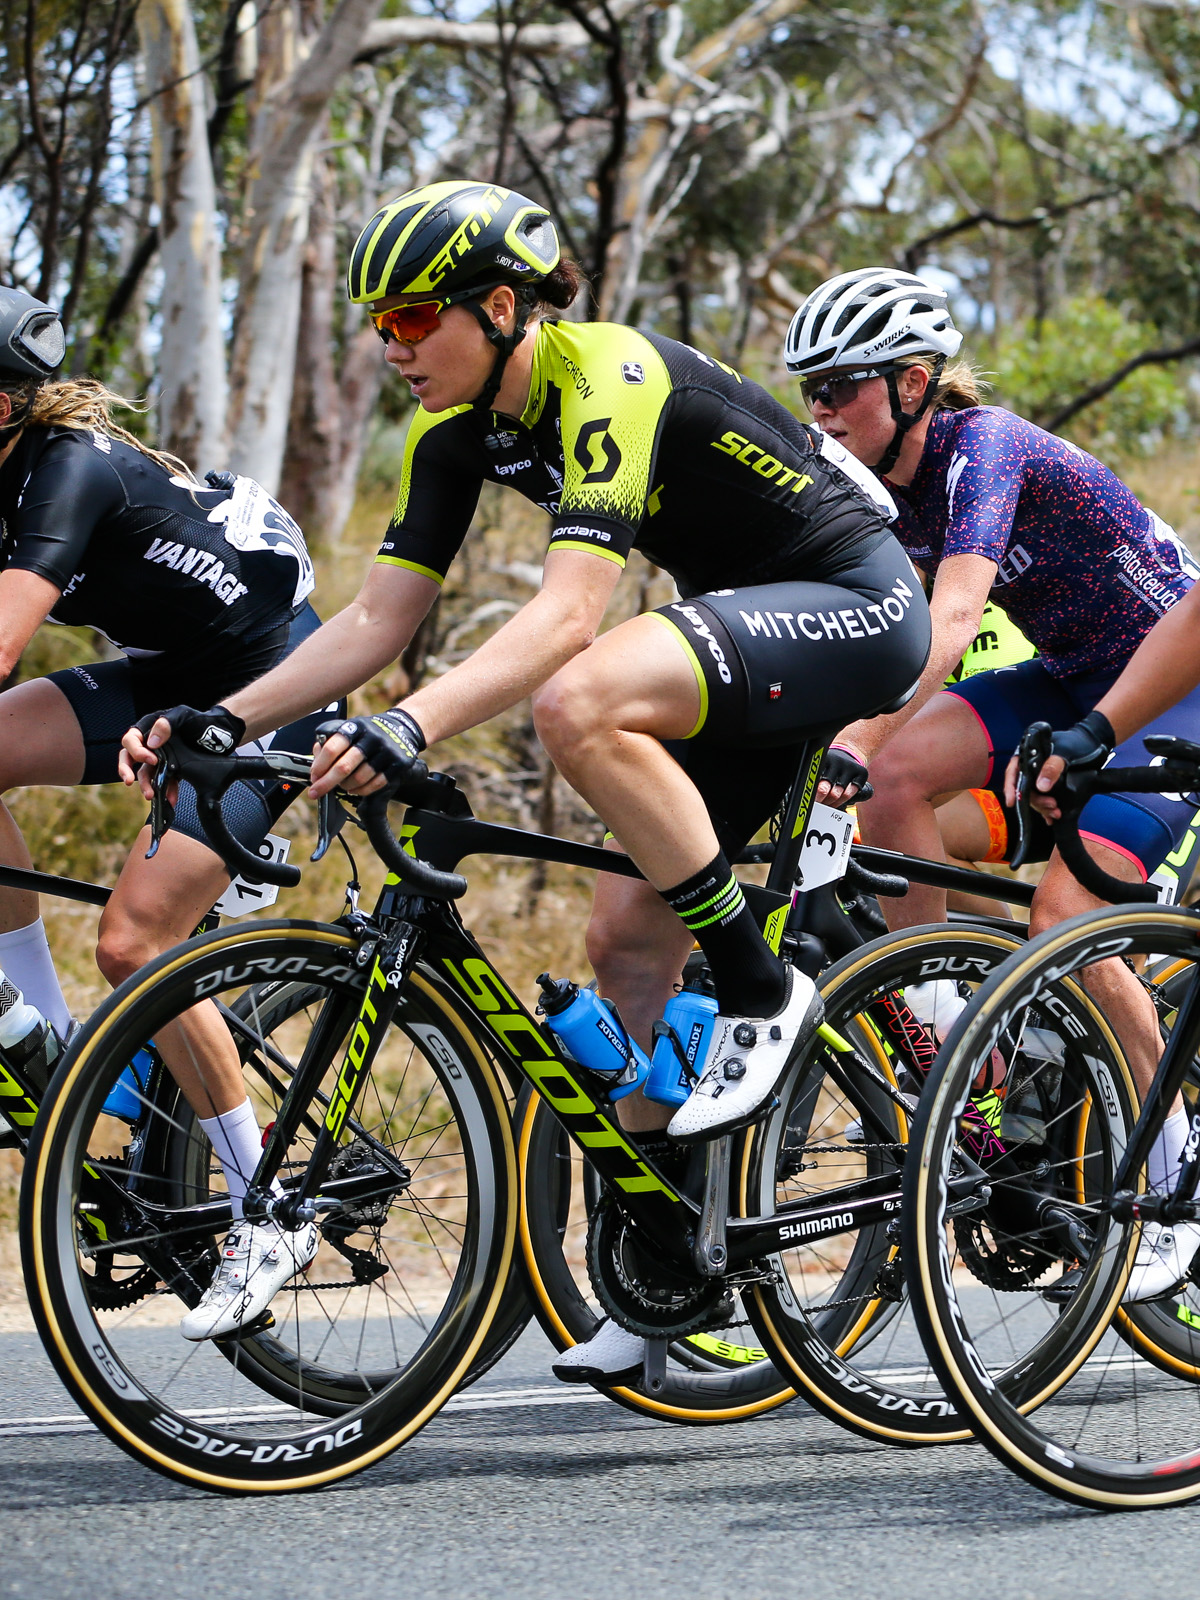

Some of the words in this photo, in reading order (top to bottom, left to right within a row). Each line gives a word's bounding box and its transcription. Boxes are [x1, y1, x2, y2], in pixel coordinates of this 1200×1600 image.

[863, 322, 911, 359] S-WORKS
[710, 430, 815, 494] SCOTT
[143, 537, 249, 607] VANTAGE
[738, 577, 914, 641] MITCHELTON
[805, 829, 838, 856] 3
[394, 937, 410, 975] ORICA
[326, 954, 391, 1143] SCOTT
[442, 957, 681, 1203] SCOTT
[778, 1211, 854, 1241] SHIMANO
[150, 1412, 363, 1464] DURA-ACE
